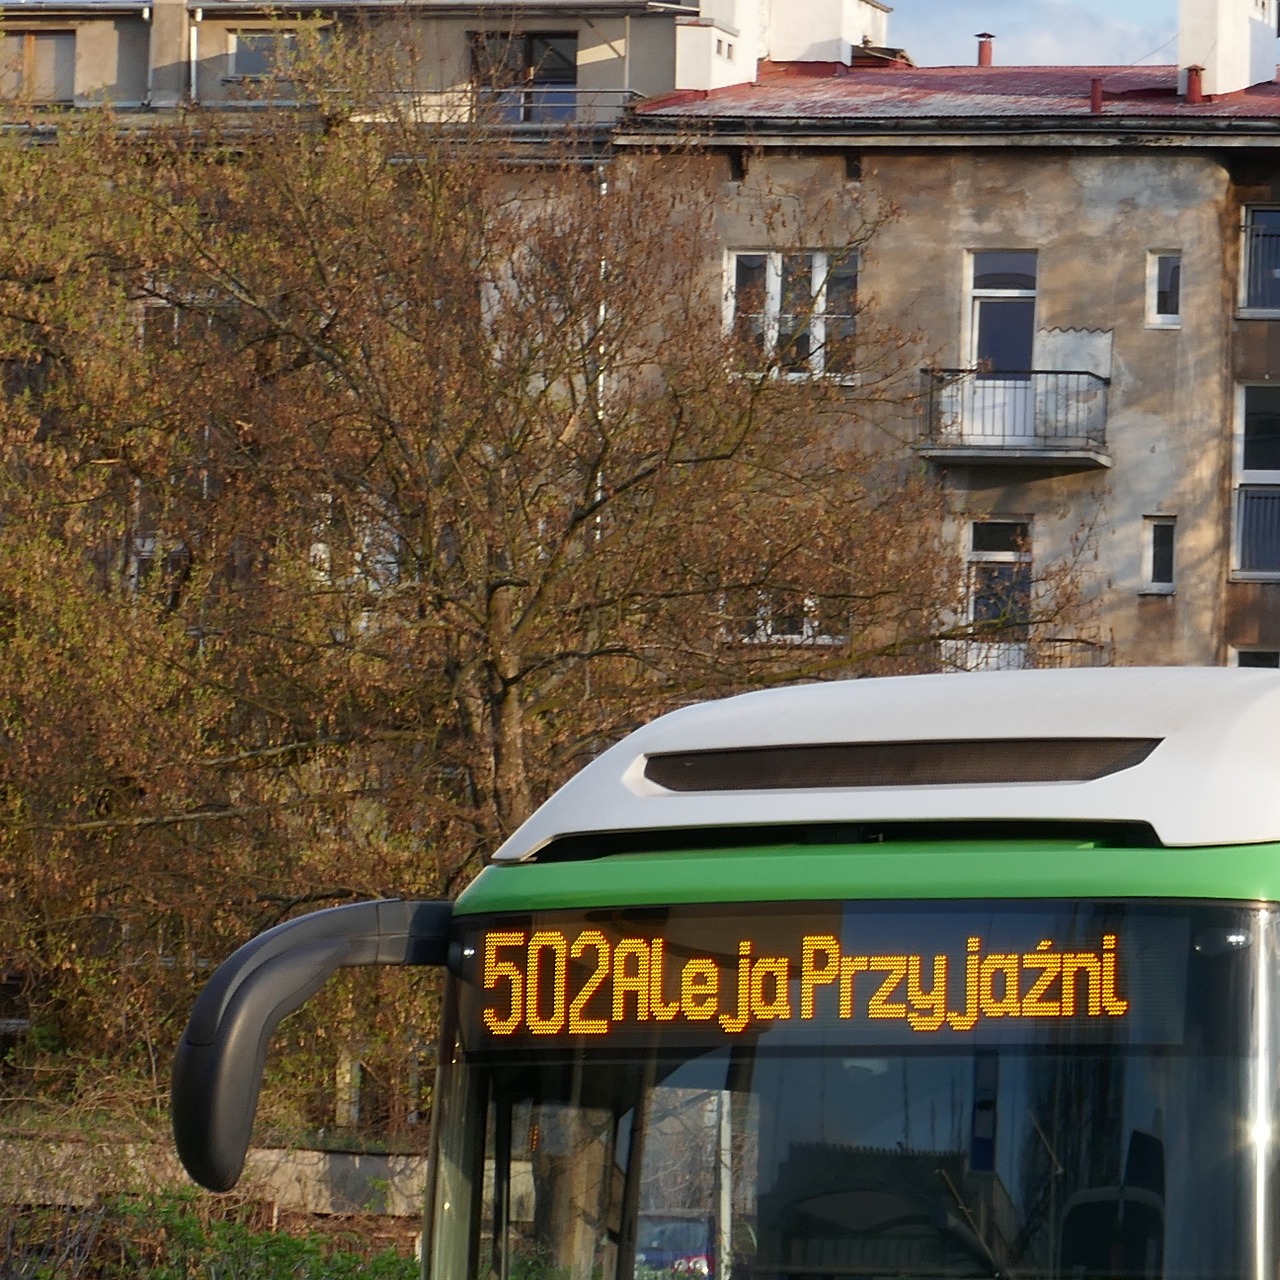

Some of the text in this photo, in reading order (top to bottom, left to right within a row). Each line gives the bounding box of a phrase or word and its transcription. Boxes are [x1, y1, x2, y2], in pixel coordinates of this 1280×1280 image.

[483, 930, 1129, 1034] 502 Aleja Przyjaźni
